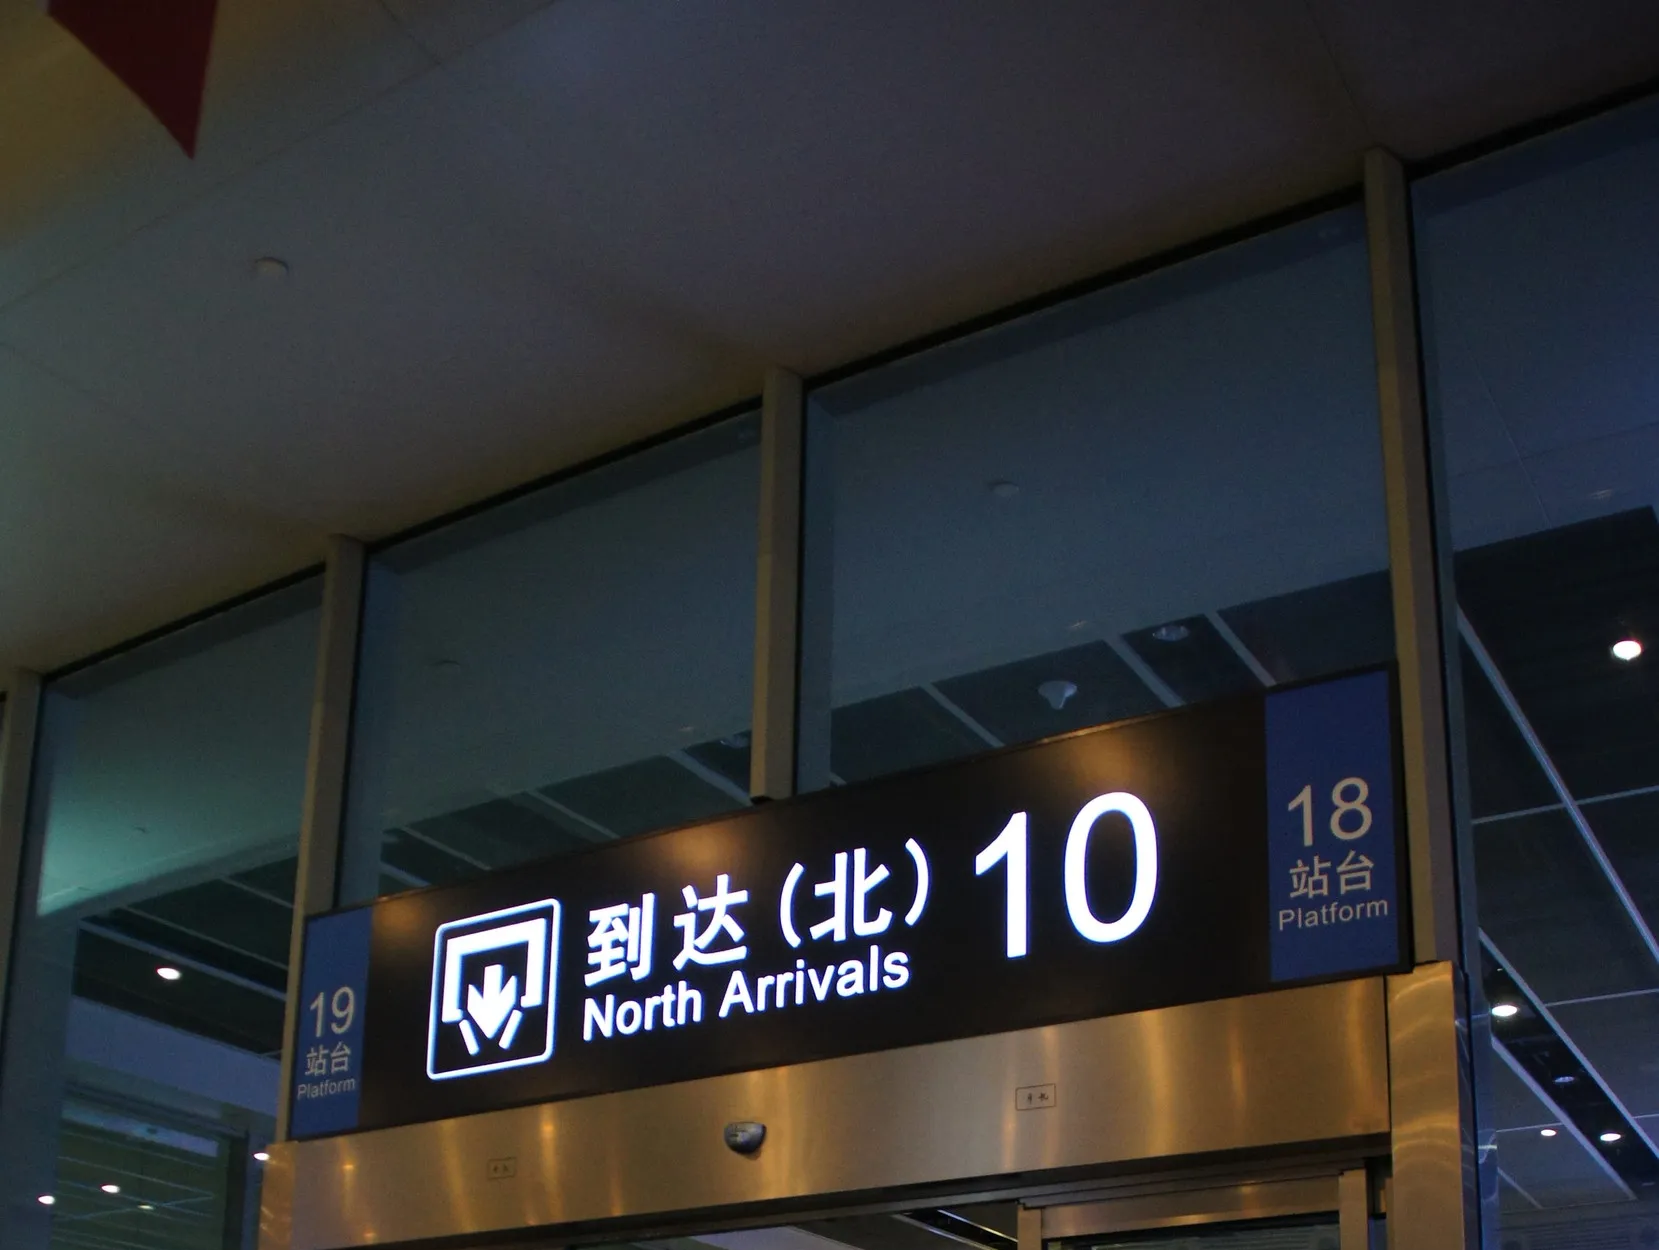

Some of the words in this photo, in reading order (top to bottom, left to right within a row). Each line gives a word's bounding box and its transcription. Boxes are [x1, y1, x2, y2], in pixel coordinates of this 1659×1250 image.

[1288, 777, 1372, 847] 18
[975, 791, 1158, 958] 10
[1289, 850, 1374, 898] 站台
[1278, 896, 1388, 931] Platform
[309, 985, 355, 1038] 19
[583, 976, 702, 1041] North
[718, 945, 910, 1018] Arrivals
[304, 1041, 351, 1077] 站台
[297, 1076, 355, 1102] Platform
